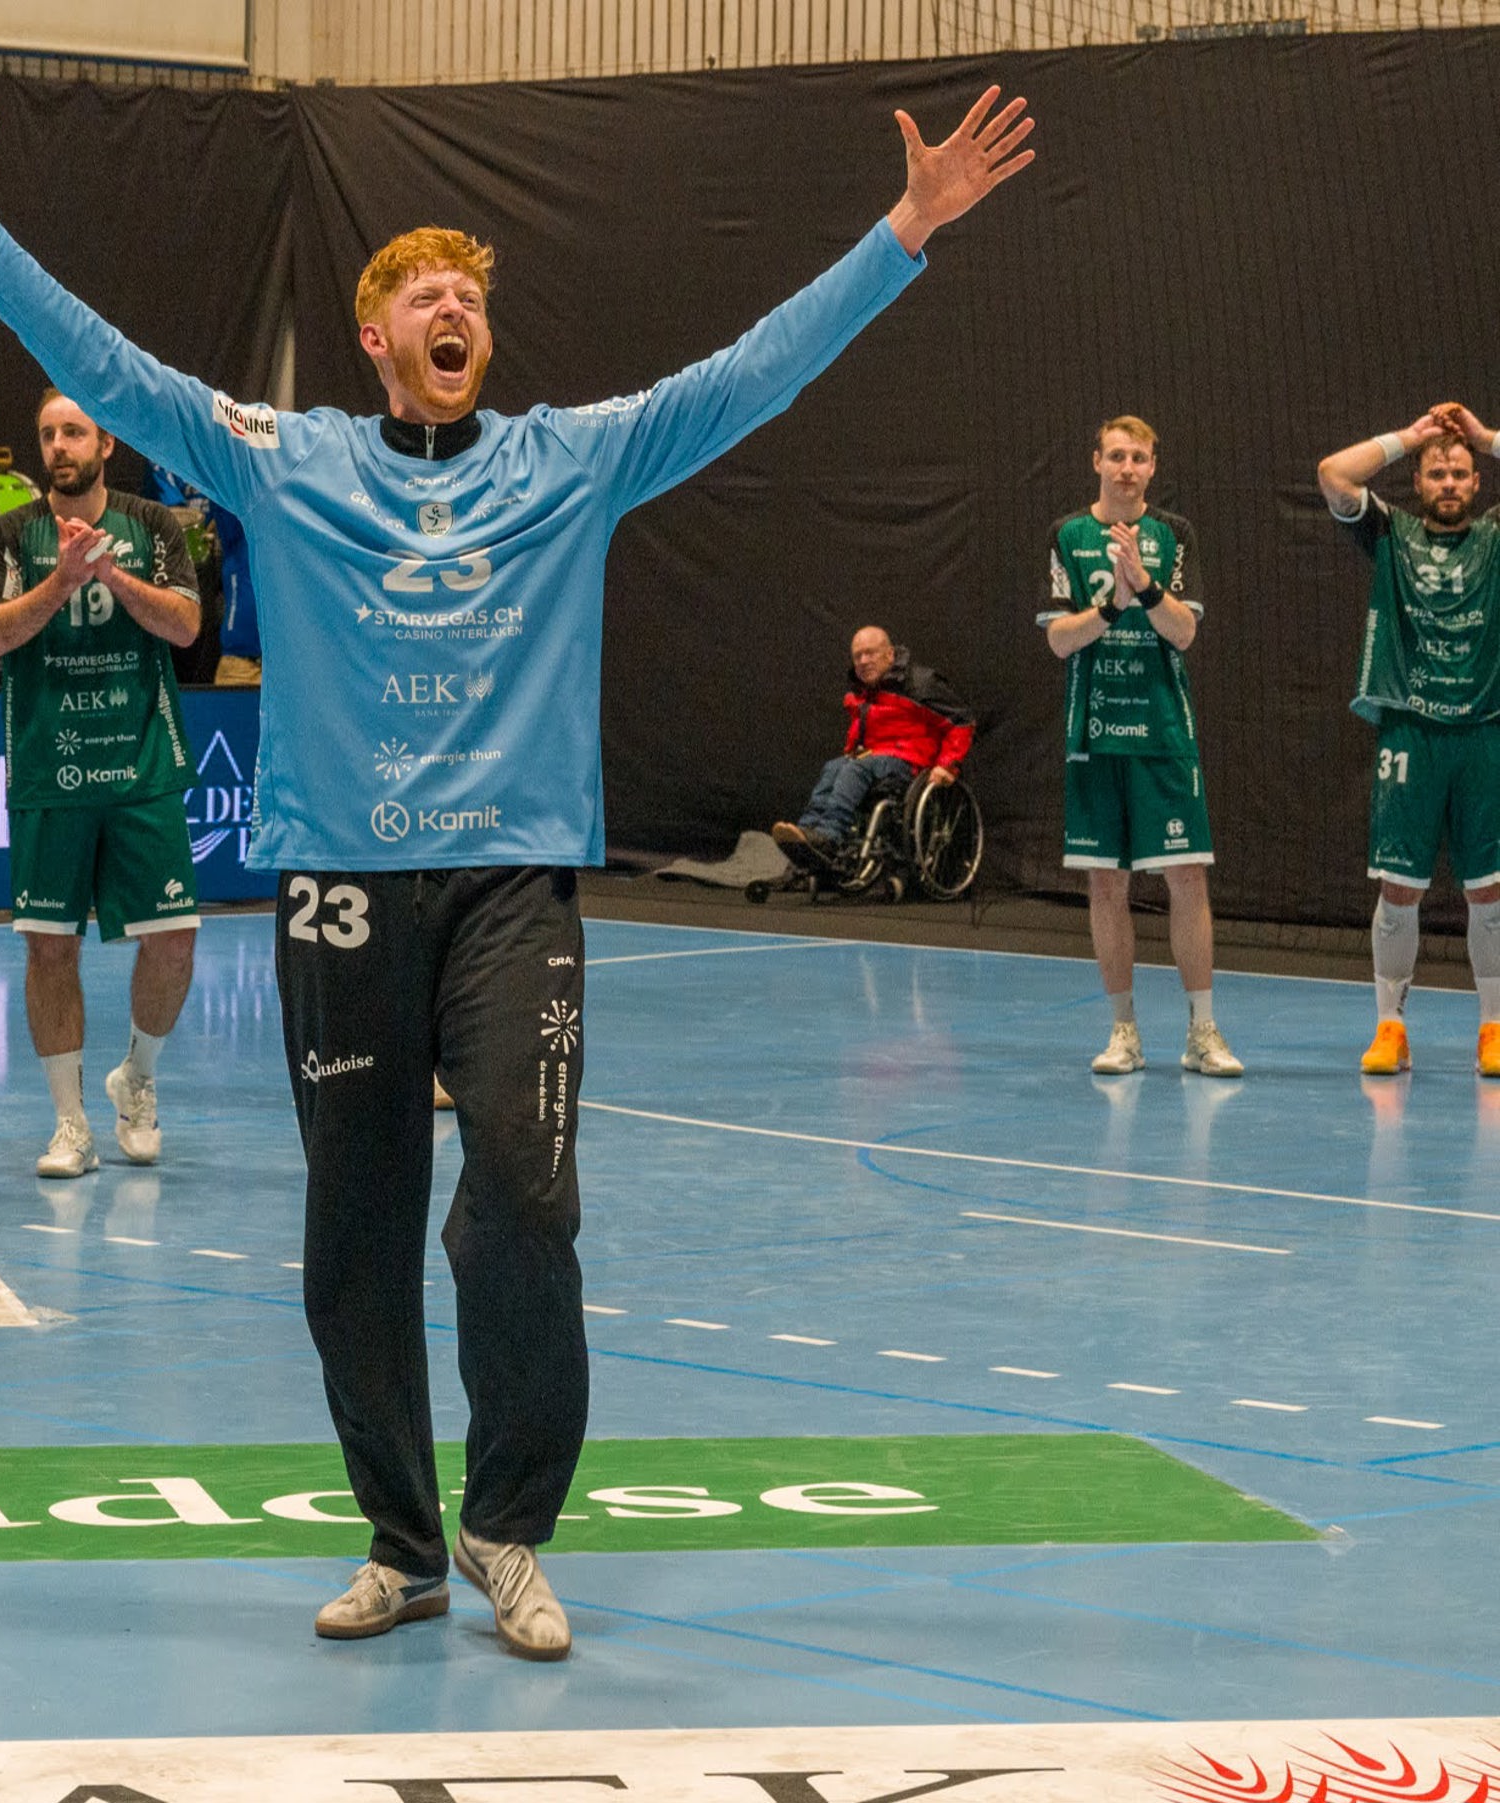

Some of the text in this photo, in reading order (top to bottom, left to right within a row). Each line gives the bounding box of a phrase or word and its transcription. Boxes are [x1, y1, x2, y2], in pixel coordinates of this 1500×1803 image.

[382, 546, 492, 593] 23
[1415, 563, 1464, 595] 31
[69, 582, 115, 626] 19
[374, 606, 524, 627] STARVEGAS.CH
[394, 625, 524, 641] CASINO INTERLAKEN
[1092, 659, 1127, 676] AEK
[380, 673, 460, 703] AEK
[59, 690, 107, 712] AEK
[85, 735, 115, 747] energie
[1105, 723, 1149, 737] Komit
[420, 748, 502, 766] energie thun
[1377, 748, 1410, 784] 31
[86, 765, 138, 784] Komit
[418, 806, 502, 831] Komit
[288, 876, 371, 949] 23
[552, 1061, 568, 1130] energie
